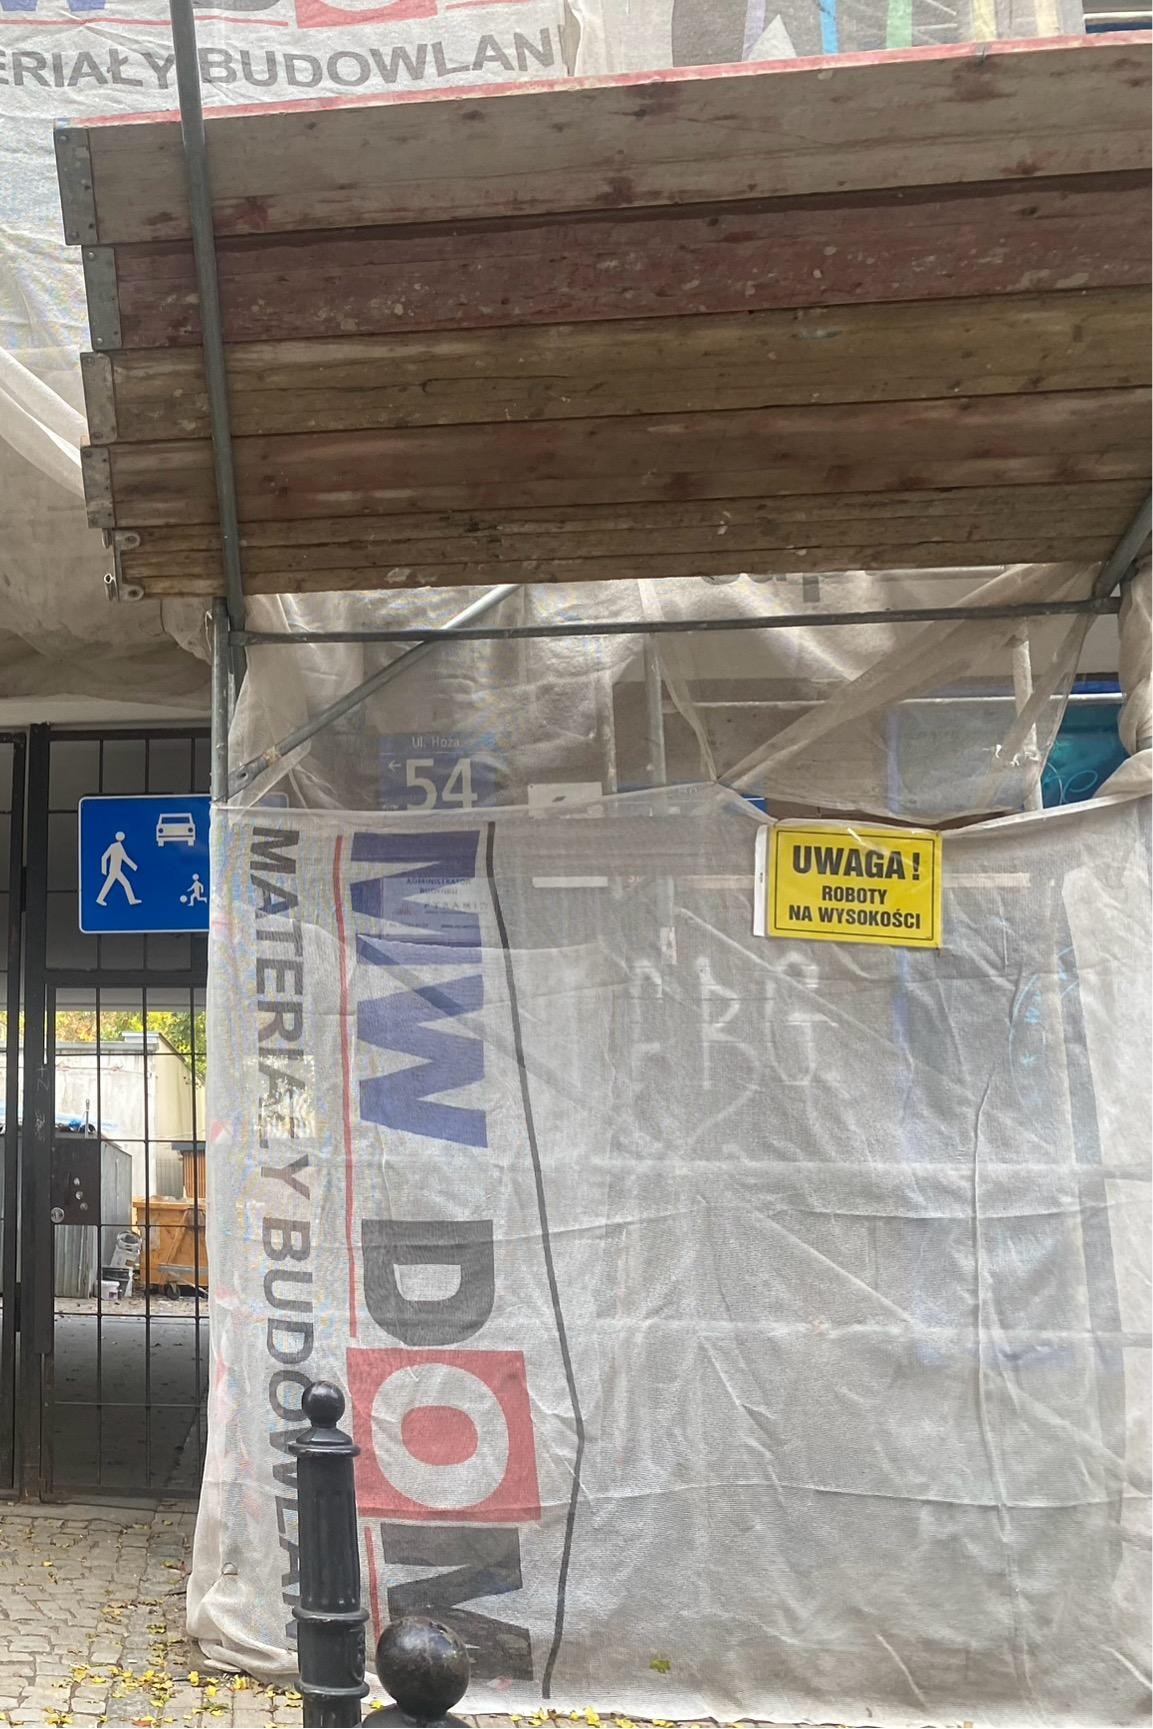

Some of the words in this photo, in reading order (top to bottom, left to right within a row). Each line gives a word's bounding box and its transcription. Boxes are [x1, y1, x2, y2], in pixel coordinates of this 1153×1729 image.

[406, 757, 478, 811] 54
[821, 885, 888, 905] ROBOTY
[788, 904, 813, 922] NA
[818, 906, 921, 930] WYSOKOŚCI
